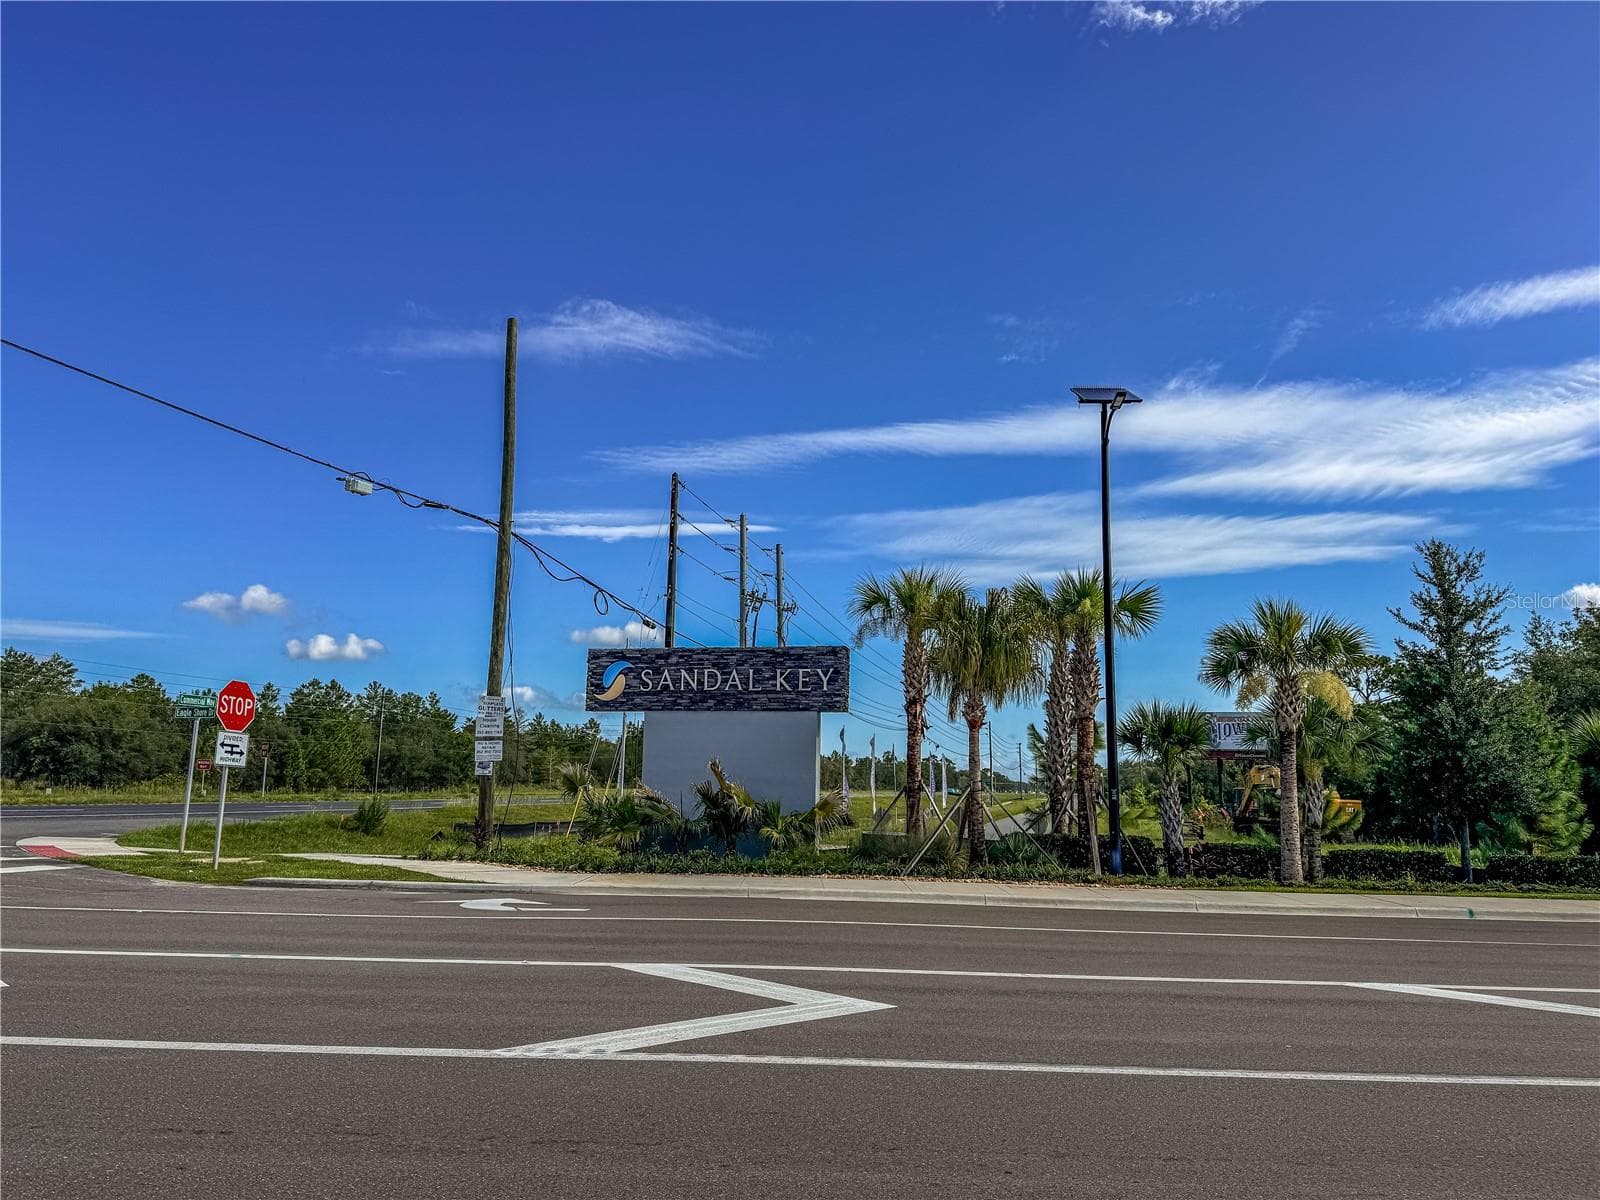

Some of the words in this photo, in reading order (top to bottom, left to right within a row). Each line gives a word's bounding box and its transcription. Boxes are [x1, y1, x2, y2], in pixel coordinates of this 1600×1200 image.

[640, 668, 762, 692] SANDAL
[775, 668, 834, 691] KEY
[220, 695, 253, 716] STOP
[176, 708, 192, 717] Eagle
[193, 708, 207, 717] Shore
[223, 734, 243, 742] DIVIDED
[219, 756, 242, 764] HIGHWAY
